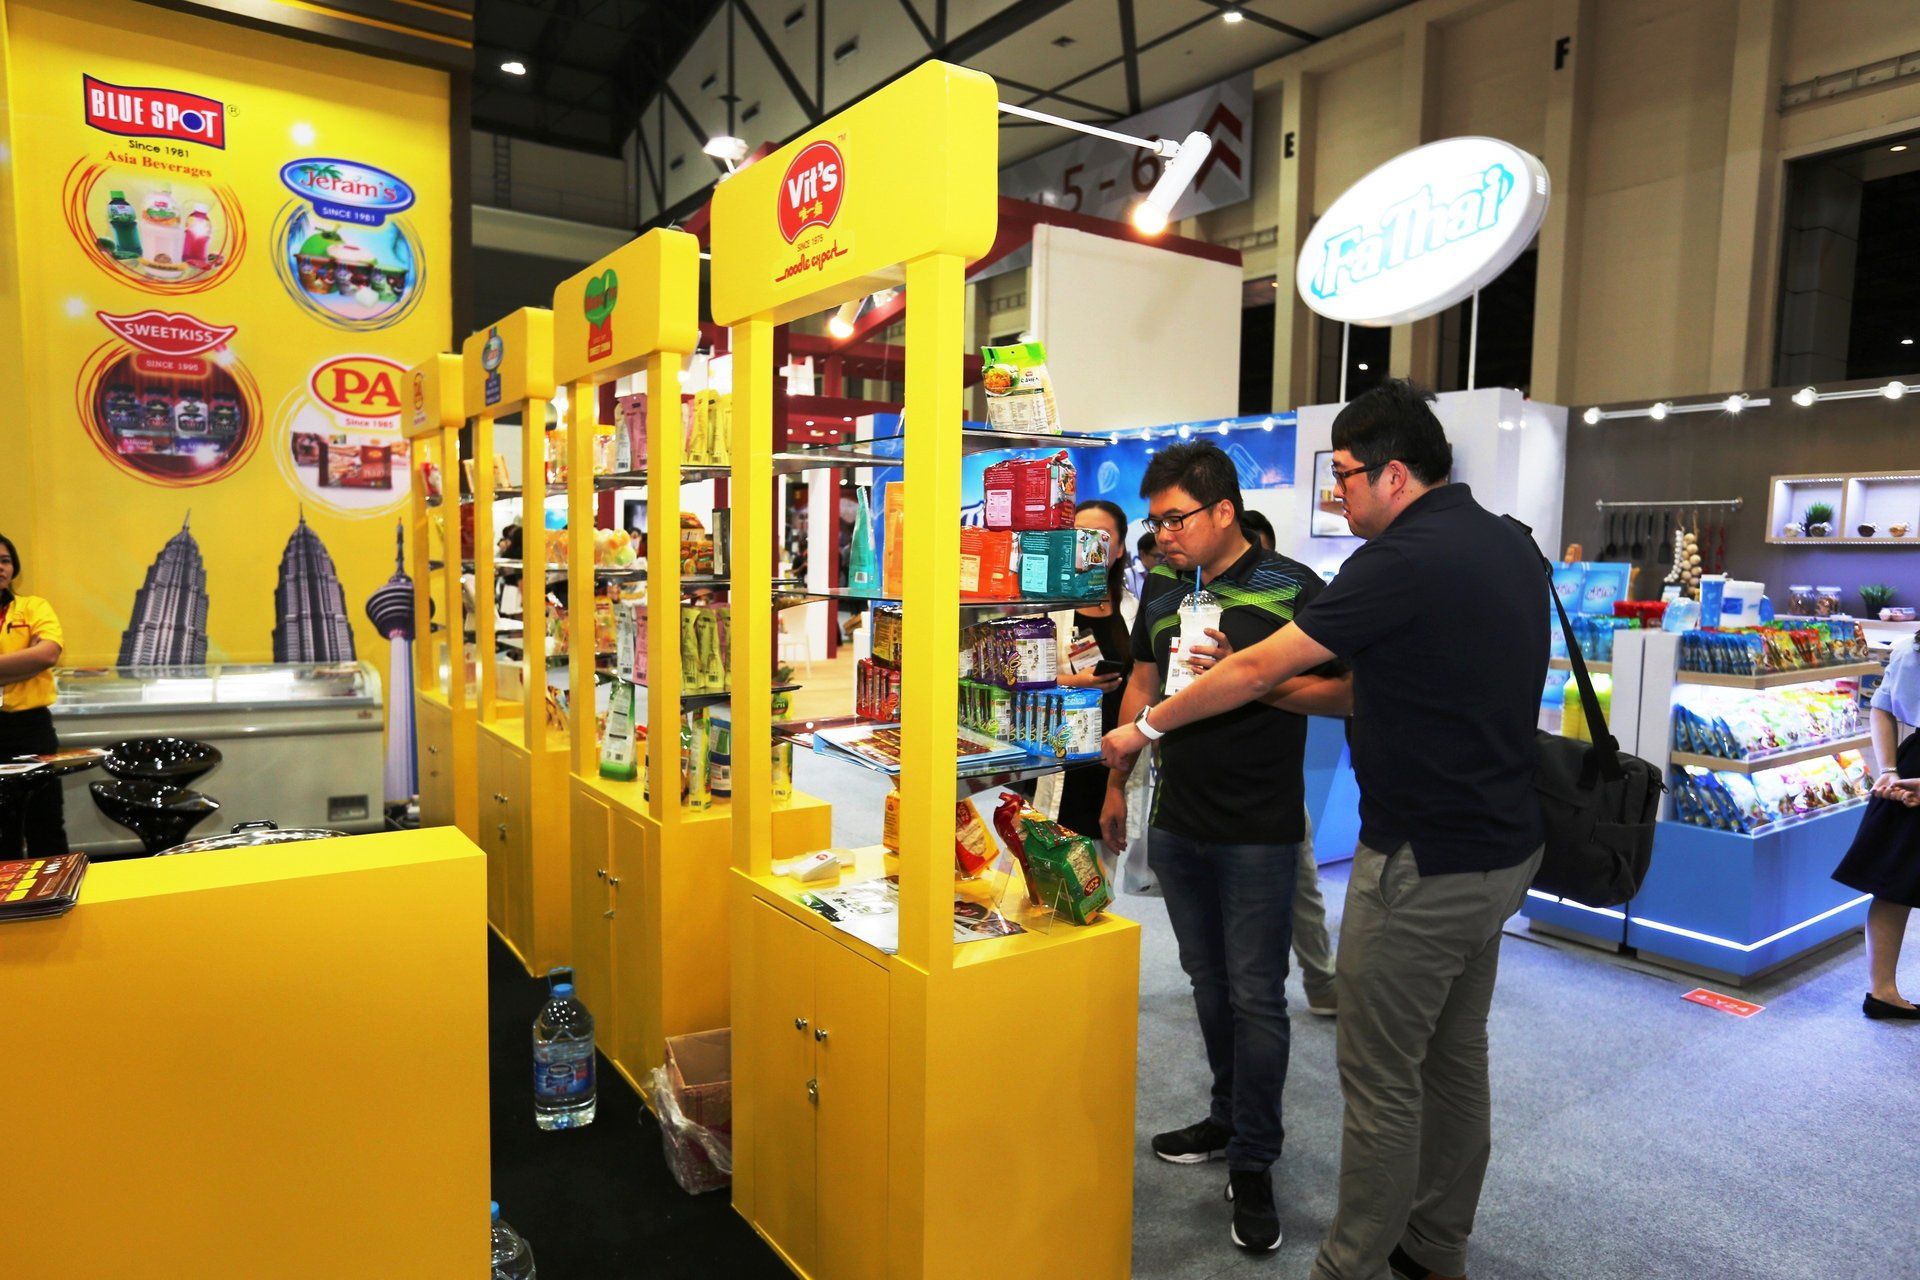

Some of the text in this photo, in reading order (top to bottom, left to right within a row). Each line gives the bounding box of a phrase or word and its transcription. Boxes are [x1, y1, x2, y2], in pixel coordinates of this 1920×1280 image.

[1555, 36, 1570, 70] F
[91, 88, 218, 138] BLUE SPOT
[128, 139, 189, 158] Since 1981
[1284, 131, 1295, 159] E
[105, 150, 212, 178] Asia Beverages
[1063, 163, 1084, 212] 5
[1131, 134, 1162, 193] 6
[301, 170, 397, 202] Jeram's
[787, 160, 838, 209] Vit's
[322, 206, 375, 222] SINCE 1981
[775, 240, 849, 283] noodle expert
[124, 323, 214, 343] SWEETKISS
[145, 359, 174, 370] SINCE
[332, 367, 402, 407] PA
[345, 418, 369, 428] Since
